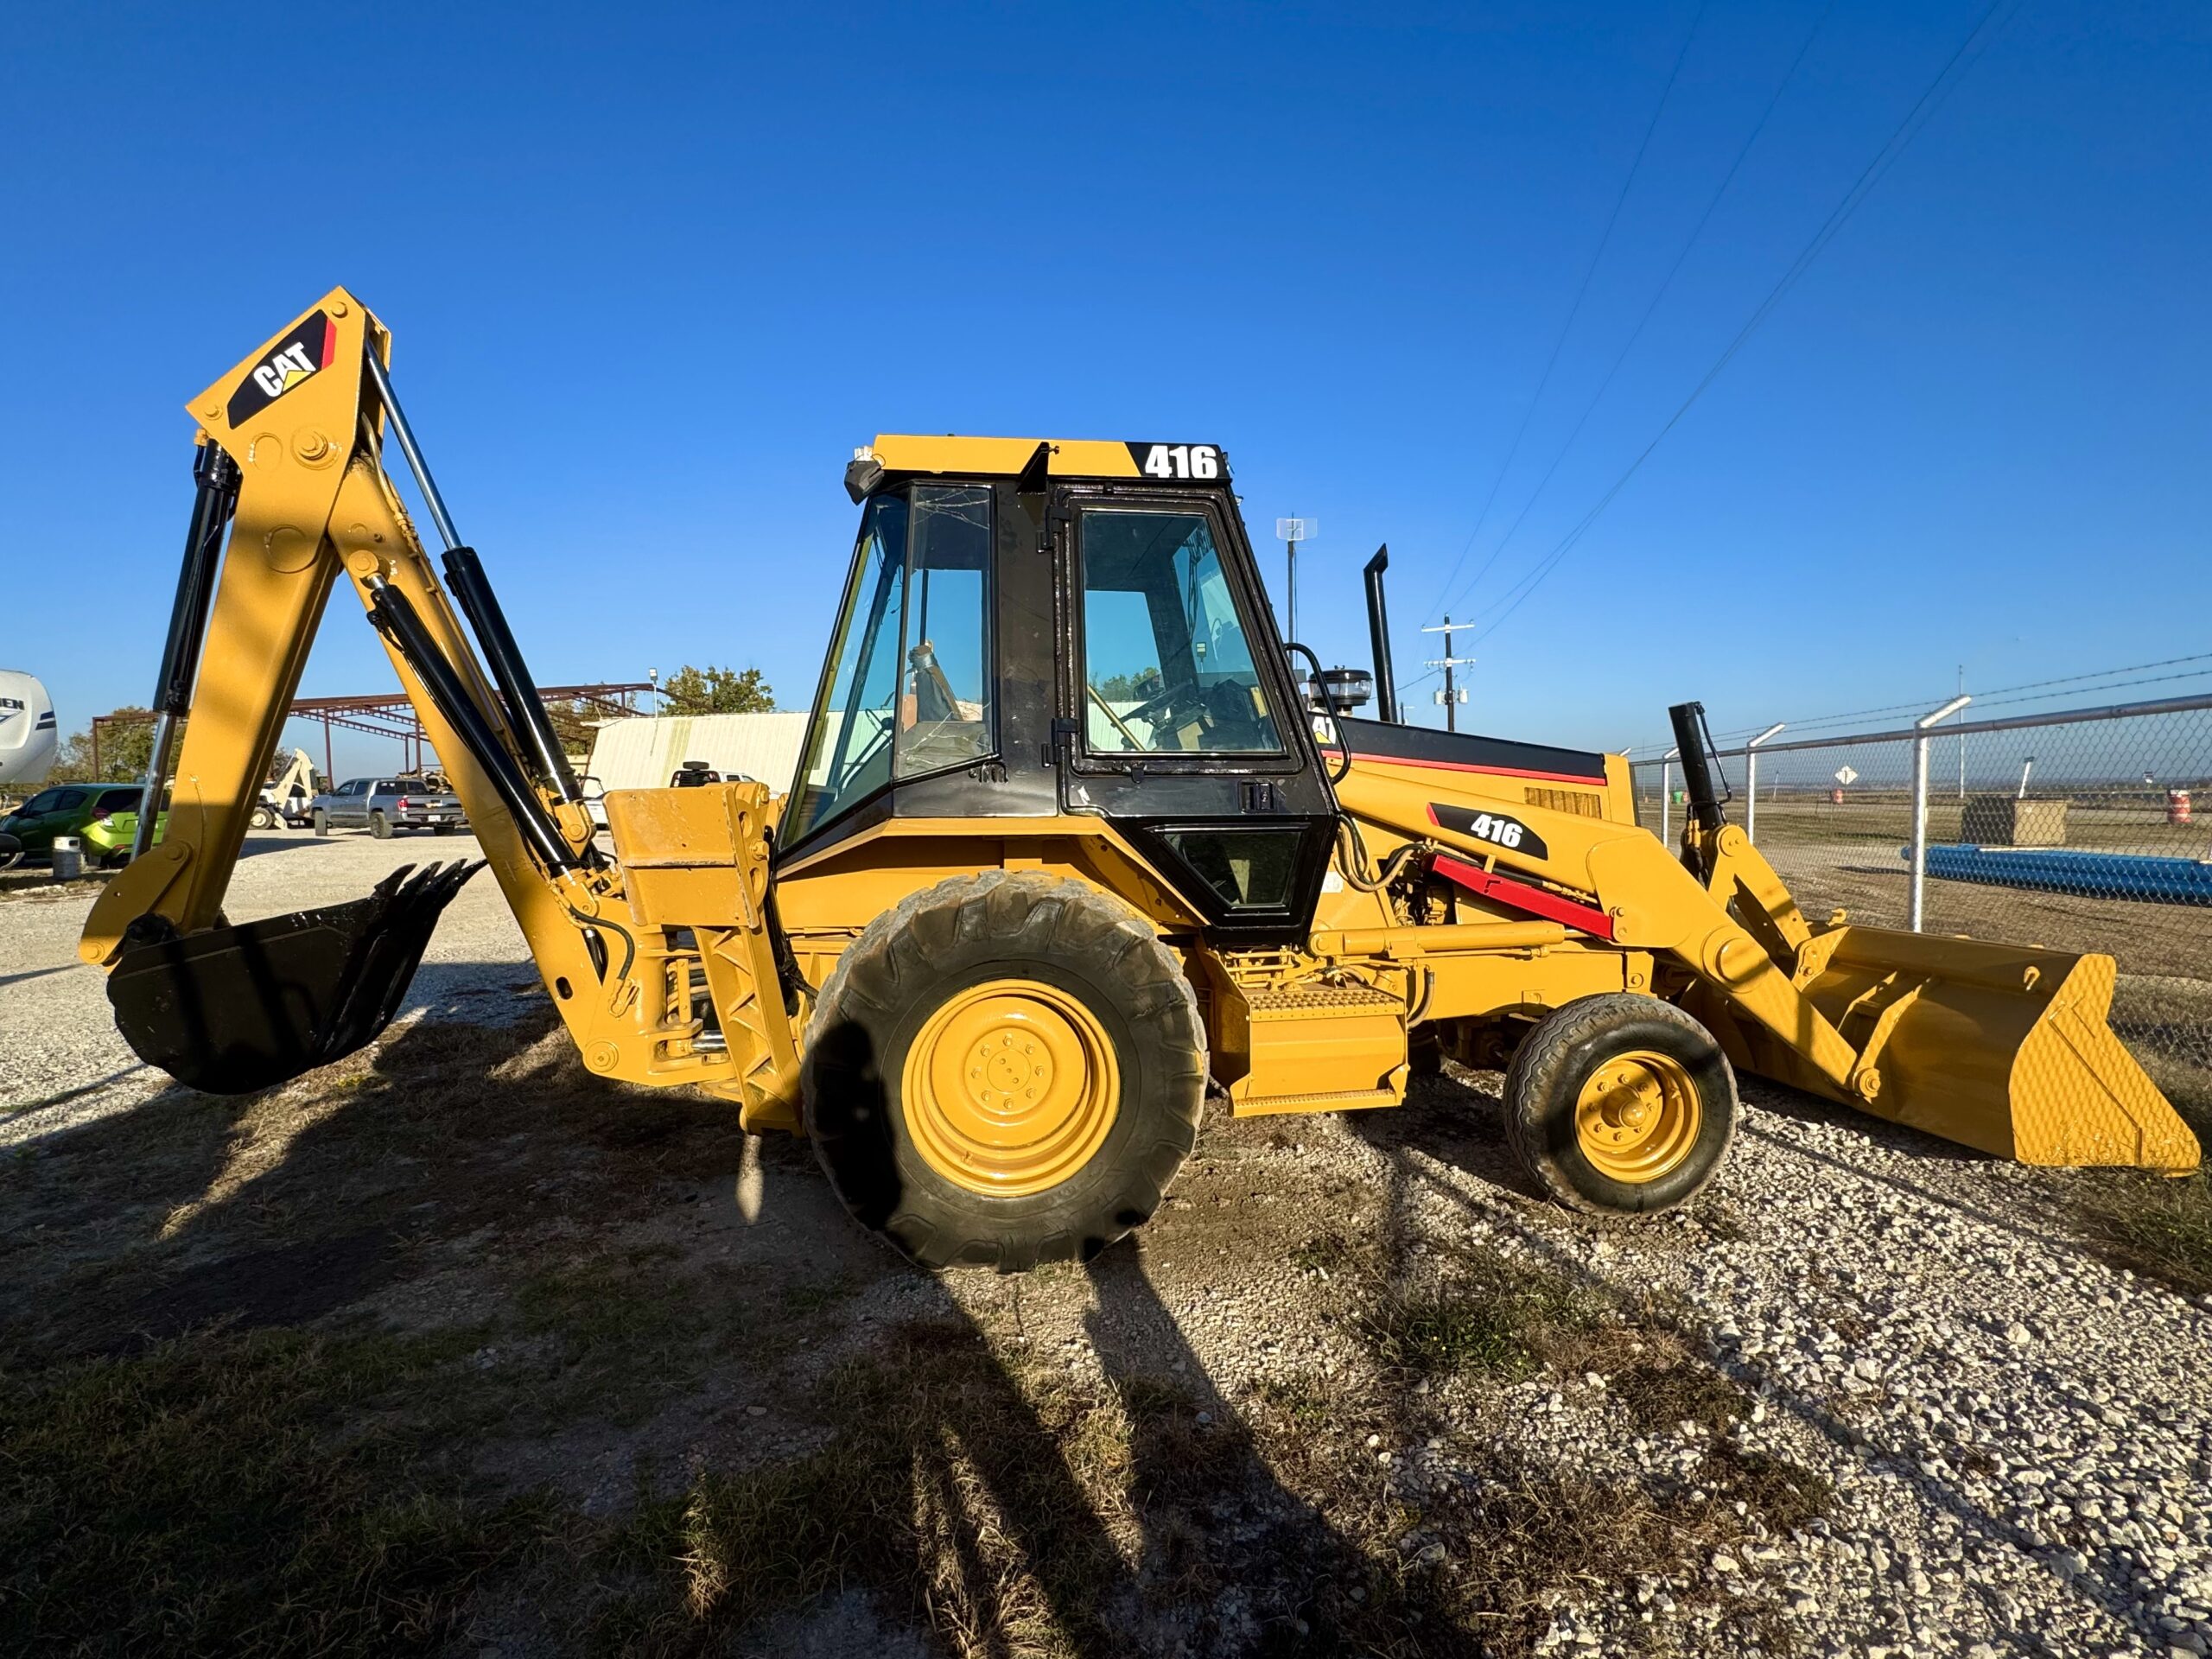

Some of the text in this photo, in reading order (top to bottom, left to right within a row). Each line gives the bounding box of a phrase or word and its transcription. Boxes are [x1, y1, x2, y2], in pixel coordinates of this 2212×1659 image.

[253, 342, 316, 397] CAT
[1145, 445, 1218, 479] 416
[0, 698, 25, 710] EN
[1313, 716, 1337, 744] AT
[1471, 814, 1523, 848] 416
